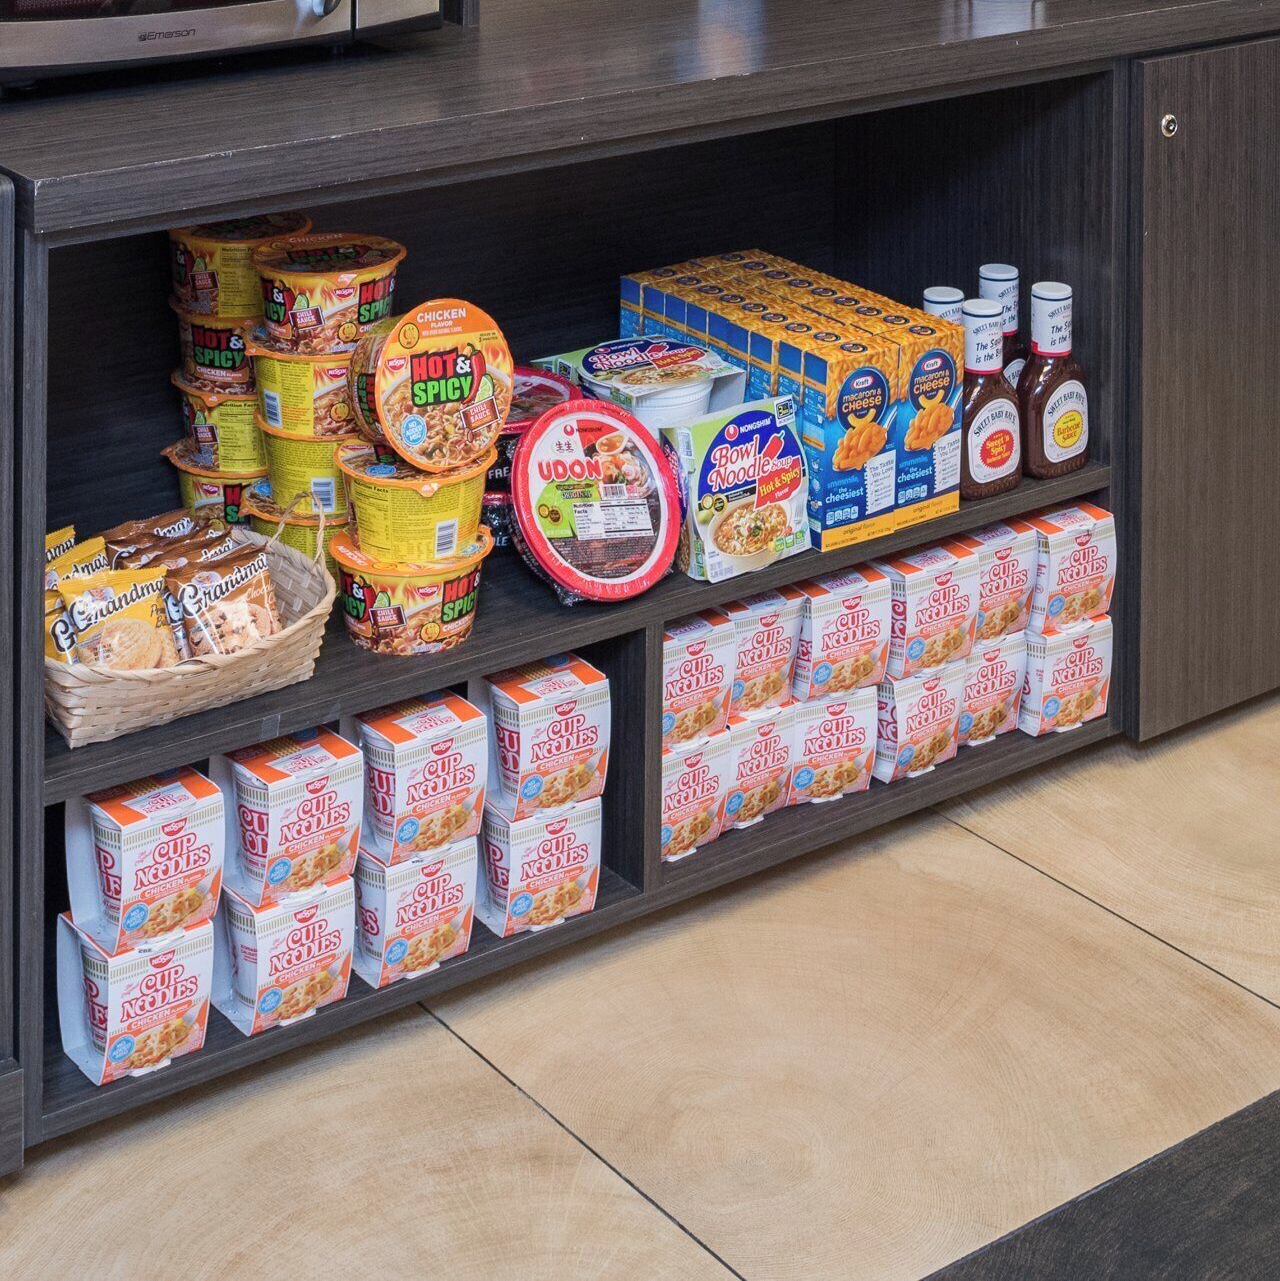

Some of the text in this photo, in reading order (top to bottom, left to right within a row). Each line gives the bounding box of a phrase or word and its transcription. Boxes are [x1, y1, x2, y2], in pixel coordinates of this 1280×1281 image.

[147, 28, 197, 41] Emerson
[417, 308, 467, 323] CHICKEN
[193, 329, 244, 349] HOT &
[195, 348, 245, 368] SPICY
[412, 351, 471, 380] HOT &
[925, 361, 939, 369] Kraft
[412, 376, 472, 406] SPICY
[854, 379, 870, 388] Kraft
[739, 417, 773, 434] NONGSHIM
[1057, 421, 1081, 437] Barbecue
[711, 433, 759, 468] Bowl
[538, 458, 604, 482] UDON
[707, 455, 793, 492] Noodle Soup
[825, 487, 864, 505] cheesiest
[537, 831, 577, 860] CUP
[520, 843, 589, 882] NOODLES
[412, 872, 453, 902] CUP
[396, 884, 465, 922] NOODLES
[286, 918, 329, 948] CUP
[269, 930, 342, 976] NOODLES
[140, 965, 184, 997] CUP
[121, 976, 199, 1023] NOODLES
